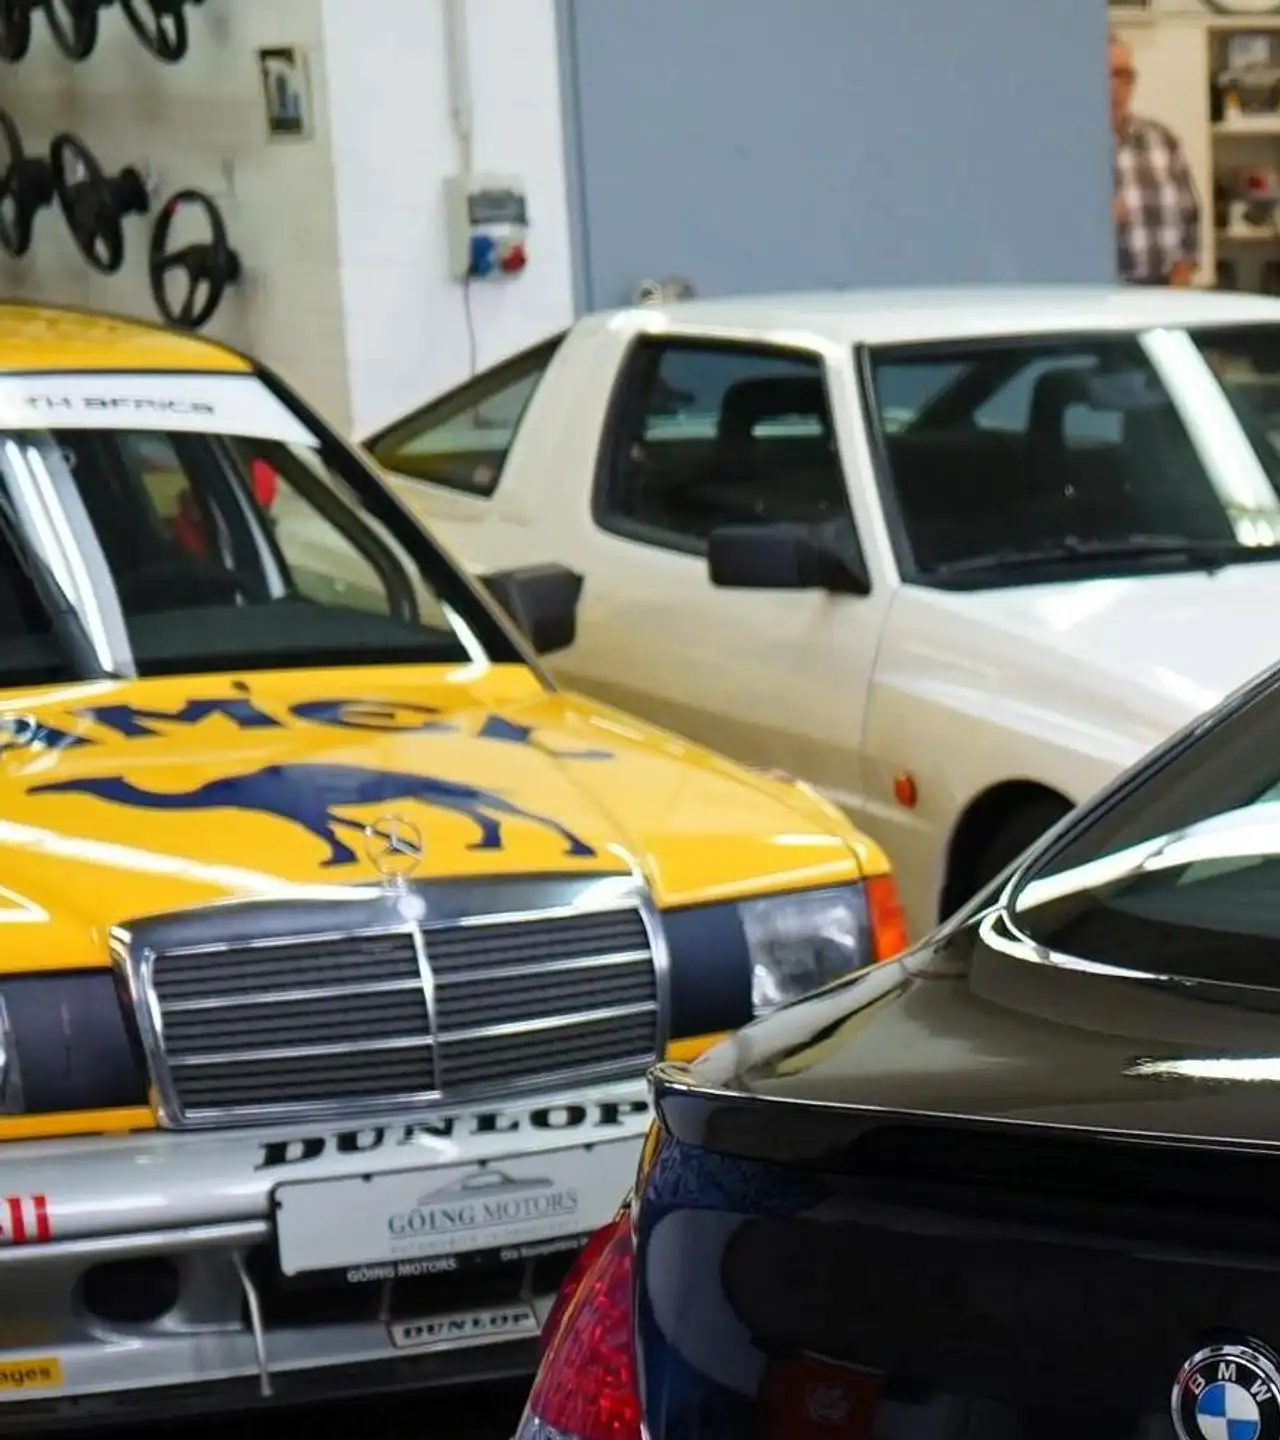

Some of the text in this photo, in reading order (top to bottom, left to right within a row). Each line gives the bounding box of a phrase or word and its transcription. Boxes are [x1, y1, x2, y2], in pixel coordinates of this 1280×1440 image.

[255, 1100, 650, 1171] DUNLOP
[481, 1188, 579, 1223] MOTORS
[402, 1312, 530, 1339] DUNLOP
[1187, 1361, 1273, 1403] BMW
